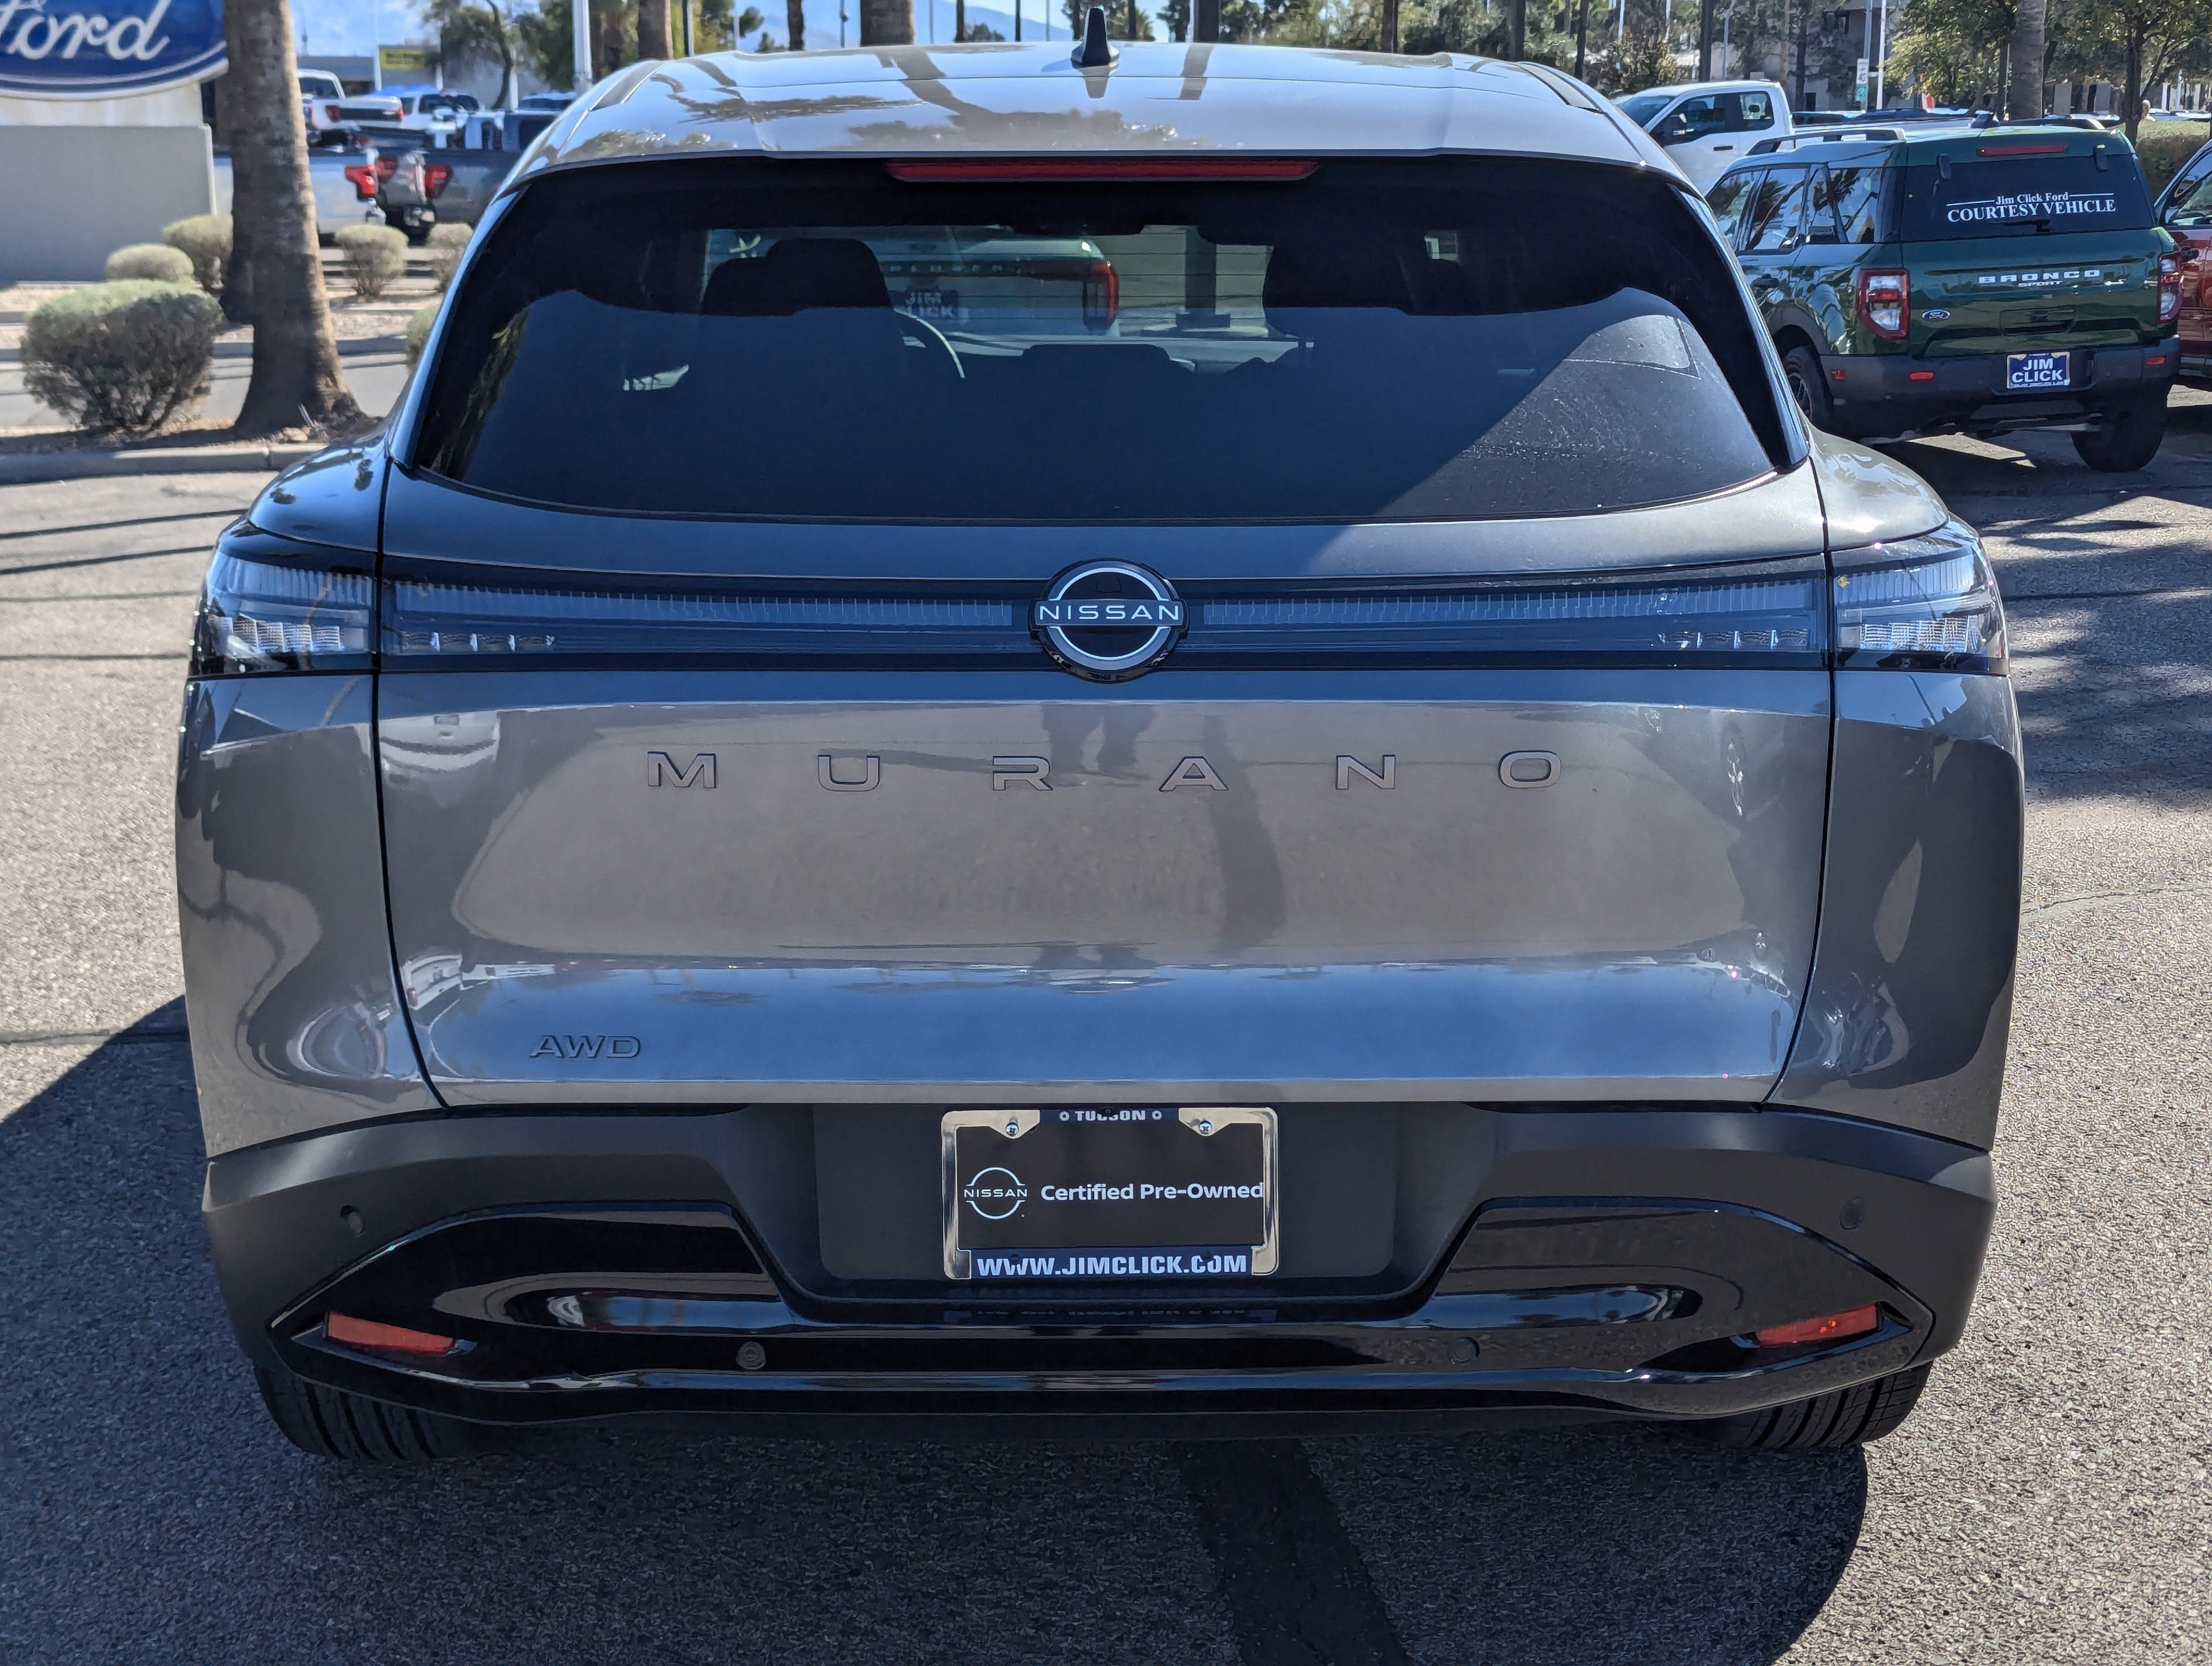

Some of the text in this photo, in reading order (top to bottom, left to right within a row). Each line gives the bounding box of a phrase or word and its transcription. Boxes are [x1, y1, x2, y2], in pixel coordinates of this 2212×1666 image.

[1996, 191, 2068, 206] Jim Click Ford
[1947, 199, 2116, 222] COURTESY VEHICLE
[1978, 270, 2100, 284] BRONCO
[2023, 358, 2053, 371] JIM
[2012, 369, 2063, 383] CLICK
[1039, 605, 1179, 620] NISSAN
[647, 750, 1562, 792] MURANO
[529, 1034, 641, 1059] AWD
[964, 1188, 1027, 1198] NISSAN
[1040, 1181, 1264, 1201] Certified Pre-Owned
[976, 1255, 1246, 1276] WWW.JIMCLICK.COM
